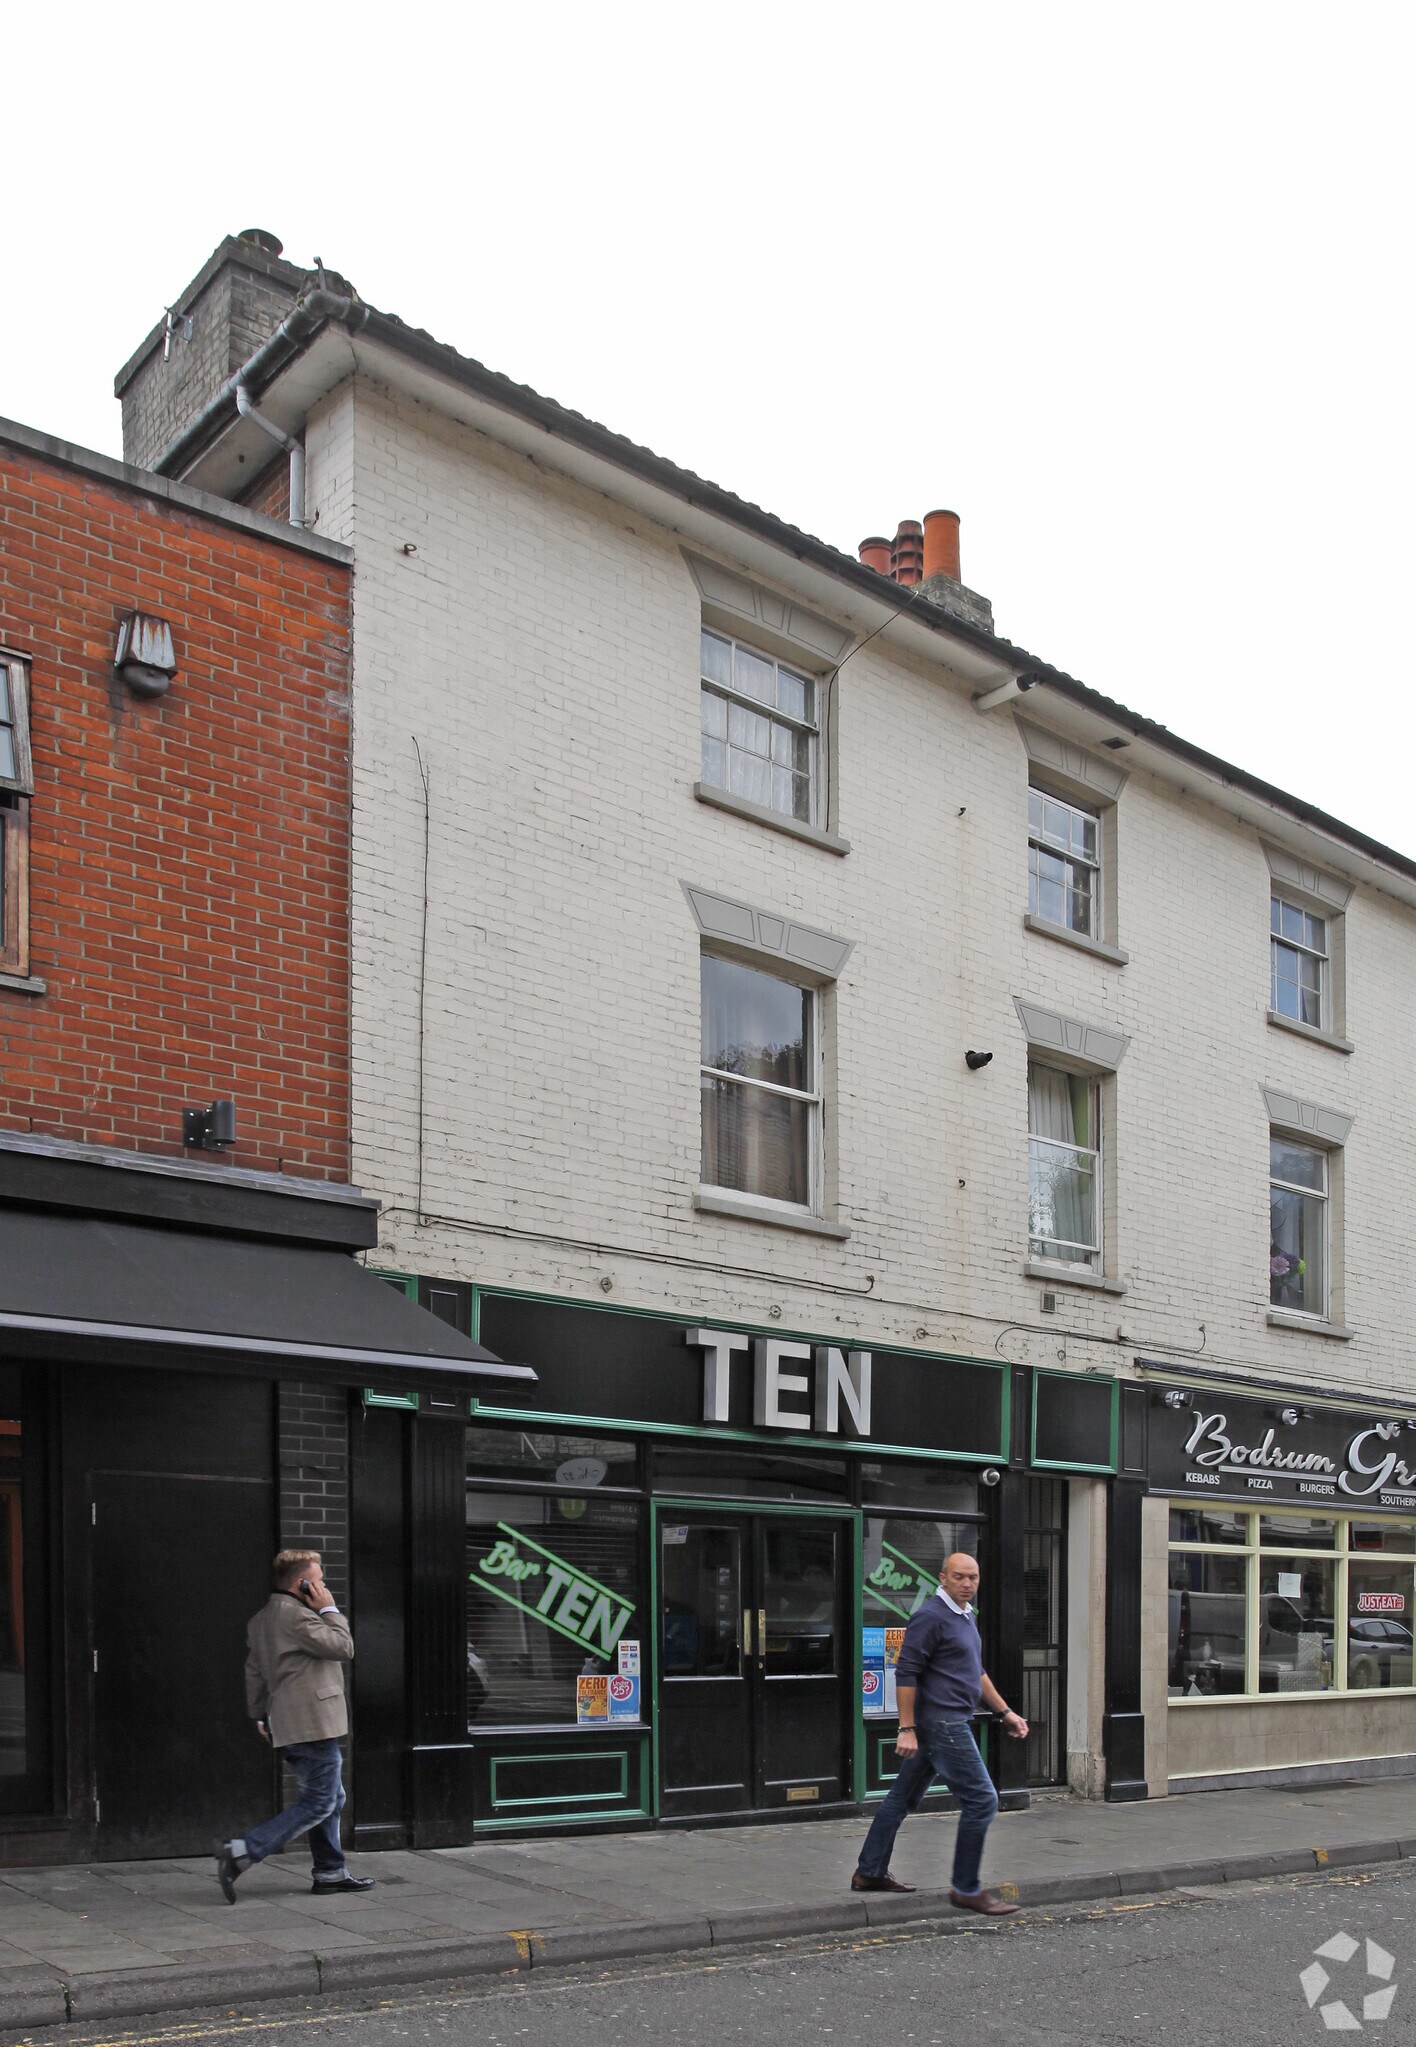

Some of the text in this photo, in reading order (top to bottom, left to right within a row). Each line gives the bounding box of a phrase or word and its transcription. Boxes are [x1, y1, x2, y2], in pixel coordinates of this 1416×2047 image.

[686, 1328, 872, 1435] TEN
[1185, 1411, 1416, 1496] Bodrum Gr
[1186, 1472, 1220, 1485] KEBABS
[1248, 1478, 1273, 1490] PIZZA
[1300, 1482, 1335, 1495] BURGERS
[870, 1557, 912, 1590] Bar
[479, 1541, 632, 1655] Bar TEN
[1359, 1596, 1381, 1608] JUST
[1381, 1596, 1398, 1608] EAT
[863, 1636, 883, 1646] cash
[579, 1677, 607, 1690] ZERO
[613, 1686, 629, 1696] 25?
